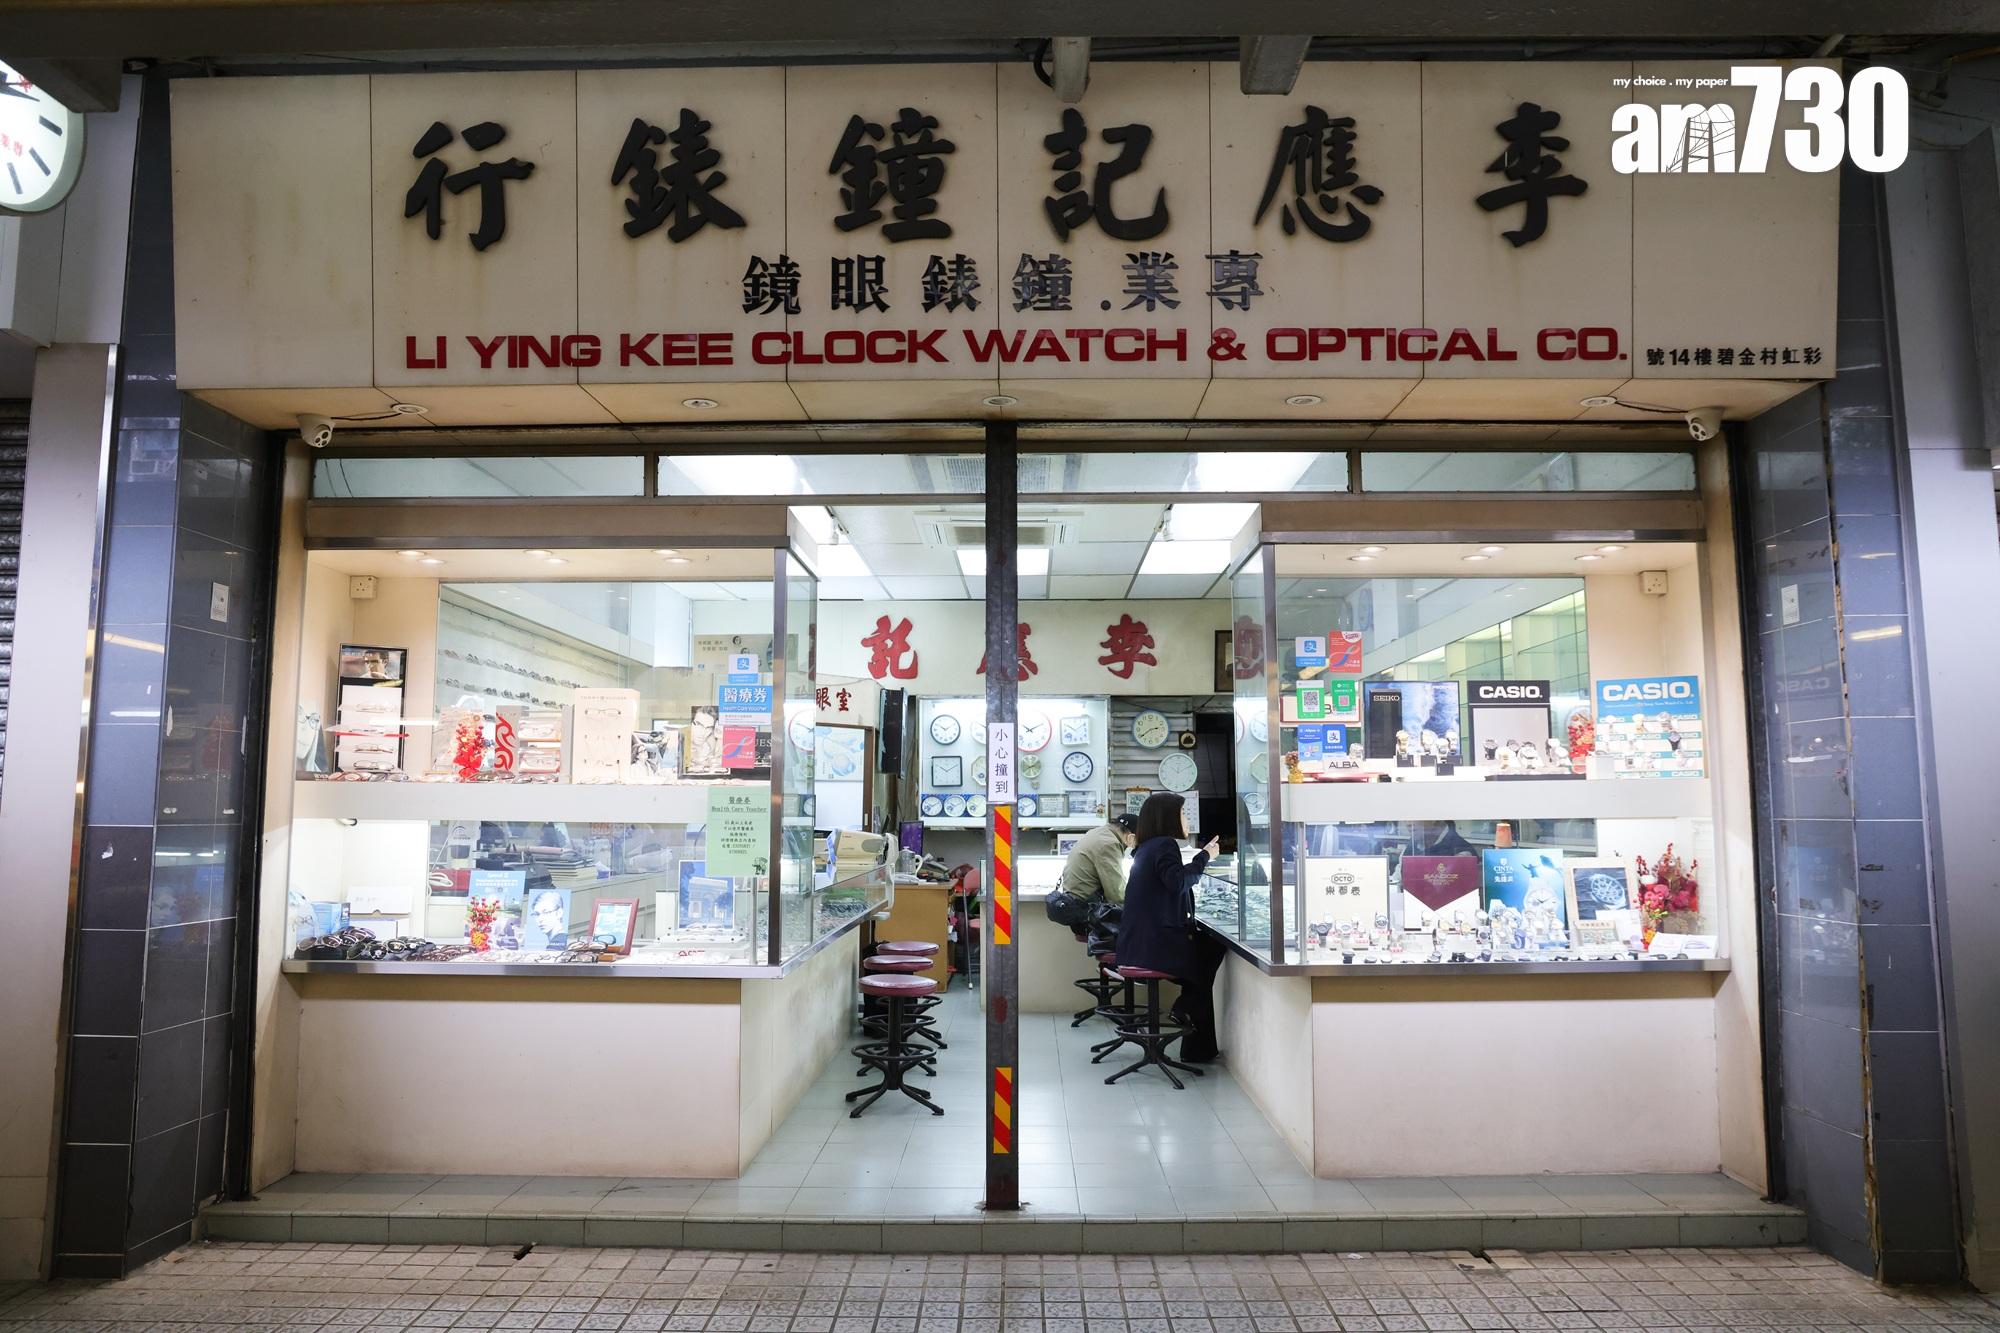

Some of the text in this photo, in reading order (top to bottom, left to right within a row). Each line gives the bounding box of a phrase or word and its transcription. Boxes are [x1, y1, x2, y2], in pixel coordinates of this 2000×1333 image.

[406, 327, 1628, 369] LI YING KEE CLOCK WATCH & OPTICAL CO.
[1373, 694, 1400, 702] SEIKO
[994, 728, 1009, 794] 小心撞到
[1329, 761, 1359, 769] ALBA
